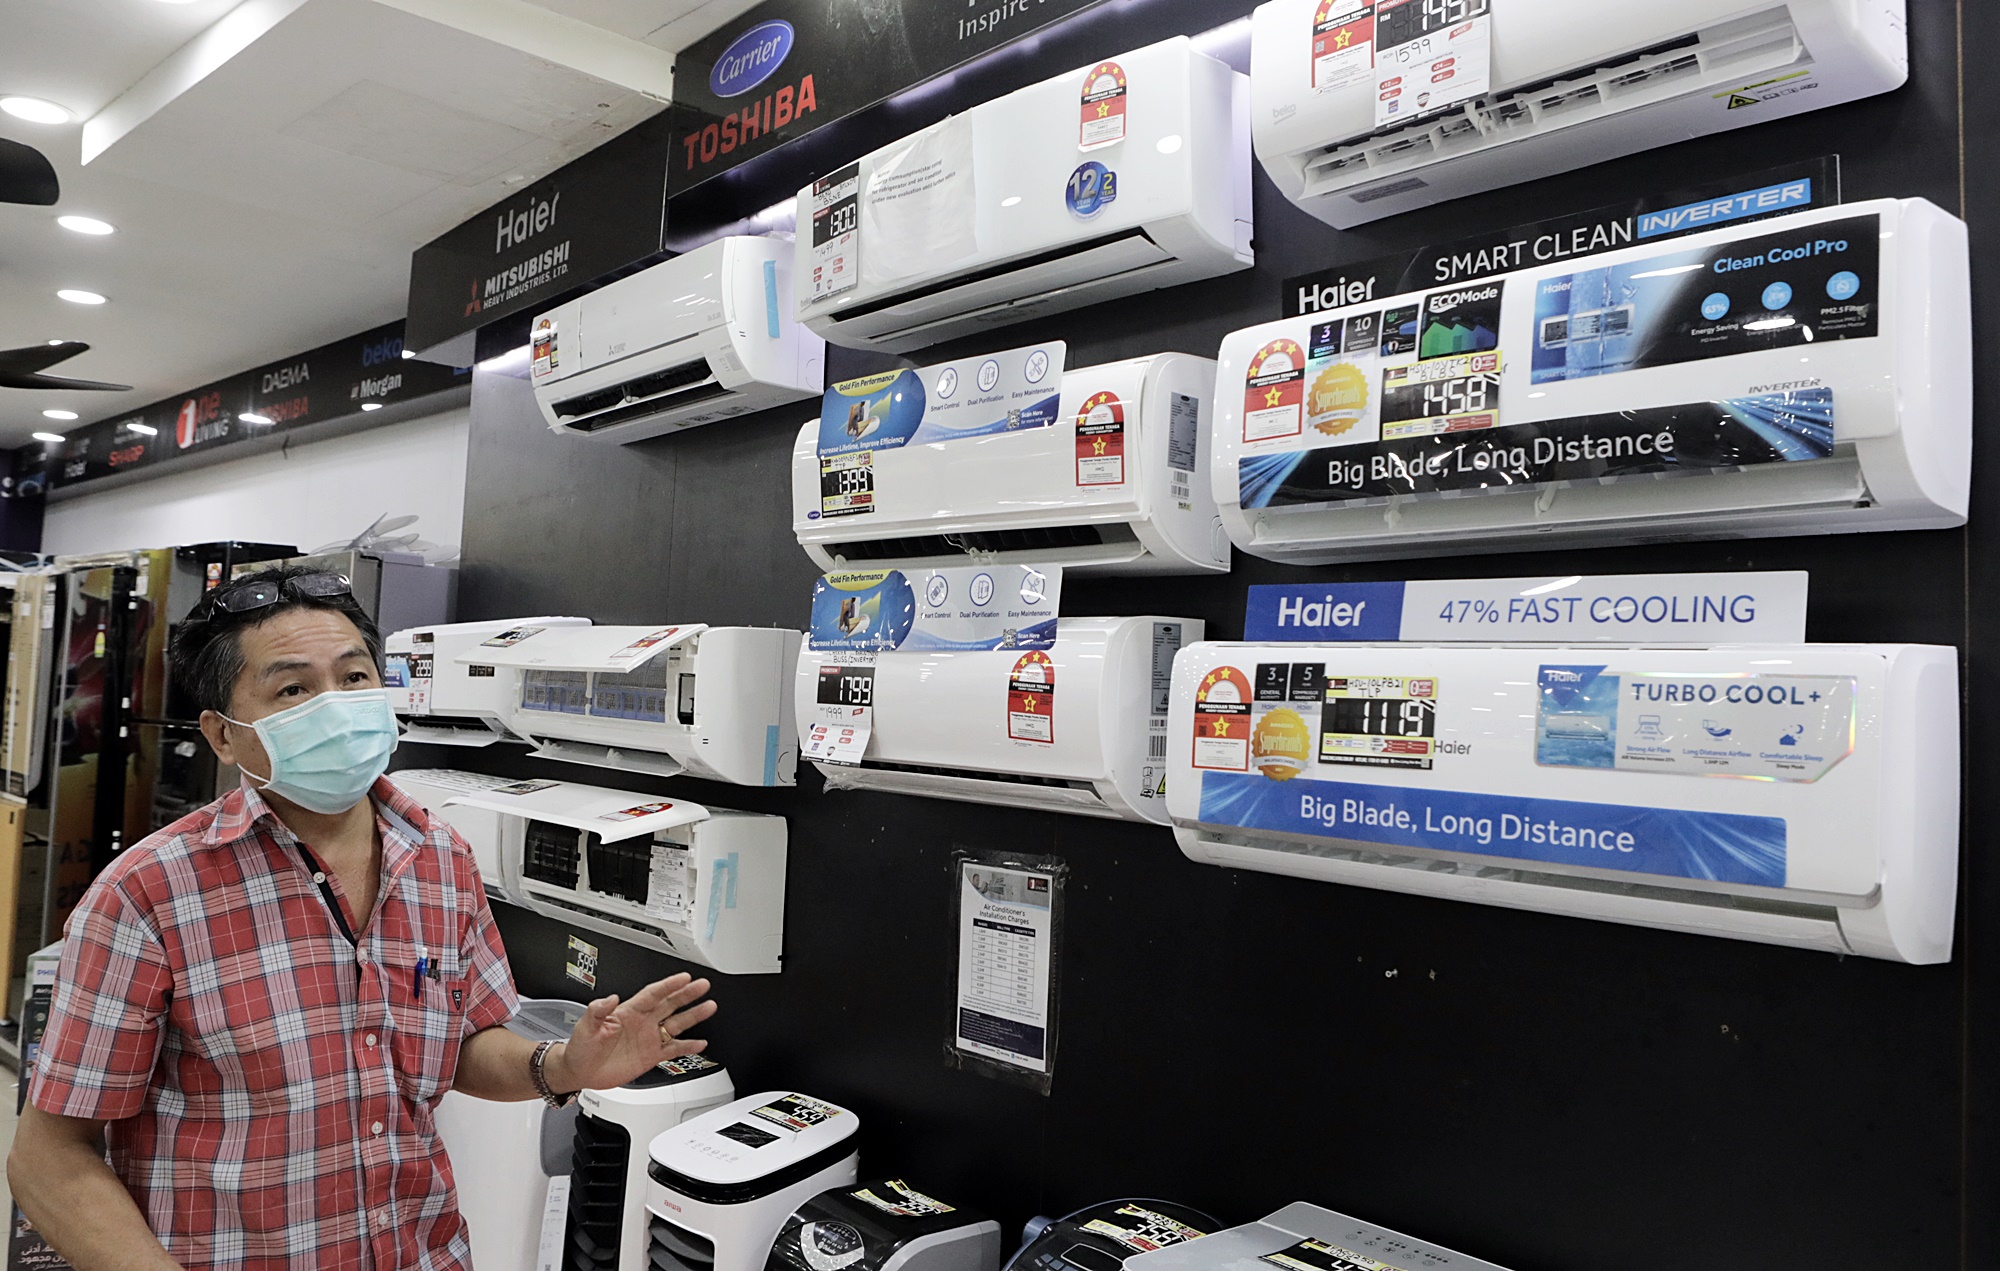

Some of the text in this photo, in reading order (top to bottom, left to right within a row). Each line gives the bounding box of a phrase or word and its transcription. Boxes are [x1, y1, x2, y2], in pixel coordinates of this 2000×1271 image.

[958, 0, 1029, 40] Inspire
[1380, 13, 1391, 22] RM
[1340, 34, 1347, 44] 3
[1394, 38, 1432, 62] 1599
[719, 35, 782, 85] Carrier
[683, 73, 817, 171] TOSHIBA
[1069, 168, 1097, 201] 12
[1102, 173, 1114, 190] 2
[496, 191, 560, 254] Haier
[830, 202, 856, 237] 1300
[1299, 276, 1376, 314] Haier
[1434, 240, 1527, 282] SMART
[1533, 217, 1633, 260] CLEAN
[1642, 183, 1805, 233] INVERTER
[1713, 239, 1848, 274] Clean Cool Pro
[484, 240, 570, 298] MITSUBISHI
[483, 293, 505, 310] HEAVY
[553, 262, 569, 280] LTD.
[1542, 282, 1572, 295] Haier
[1429, 287, 1498, 311] ECOMode
[1321, 325, 1331, 338] 3
[1354, 316, 1372, 332] 10
[1691, 322, 1739, 337] Energy Saving
[362, 337, 403, 367] beko
[1313, 345, 1335, 354] GENERAL
[360, 373, 402, 399] Morgan
[838, 373, 896, 393] Gold Fin Performance
[1748, 378, 1822, 394] INVERTER
[967, 394, 1005, 406] Dual Purification
[1011, 386, 1055, 399] Easy Maintenance
[1270, 393, 1276, 401] 4
[1315, 384, 1360, 412] Superbrands
[1423, 376, 1487, 417] 1458
[930, 401, 960, 412] Smart Control
[819, 445, 839, 455] Increase
[859, 440, 880, 449] Improve
[879, 436, 905, 447] Efficiency
[1097, 441, 1103, 452] 3
[1328, 431, 1675, 489] Big Blade, Long Distance
[839, 469, 868, 494] 1399
[830, 573, 884, 584] Gold Fin Performance
[934, 611, 951, 619] Control
[971, 610, 1000, 618] Purification
[1007, 609, 1052, 618] Easy Maintenance
[1278, 593, 1757, 629] Haier 47% FAST COOLING
[1267, 667, 1277, 681] 3
[1303, 666, 1313, 681] 5
[1547, 670, 1584, 683] Haier
[840, 676, 873, 704] 1799
[1358, 687, 1381, 698] TLP
[1631, 683, 1718, 703] TURBO
[825, 706, 843, 719] 1999
[1363, 701, 1424, 737] 1119
[1218, 723, 1224, 732] 3
[1259, 730, 1302, 755] Superbrands
[1433, 740, 1472, 755] Haier
[1626, 745, 1648, 754] Strong
[1682, 748, 1752, 758] Long Distance Airflow
[1759, 751, 1824, 762] Comfortable Sleep
[1300, 794, 1635, 853] Big Blade, Long Distance
[979, 910, 1030, 925] Installation Charges
[984, 903, 1025, 917] Air Conditioner's
[792, 1105, 825, 1124] 459
[663, 1199, 682, 1213] aiwa
[1137, 1219, 1181, 1245] 358
